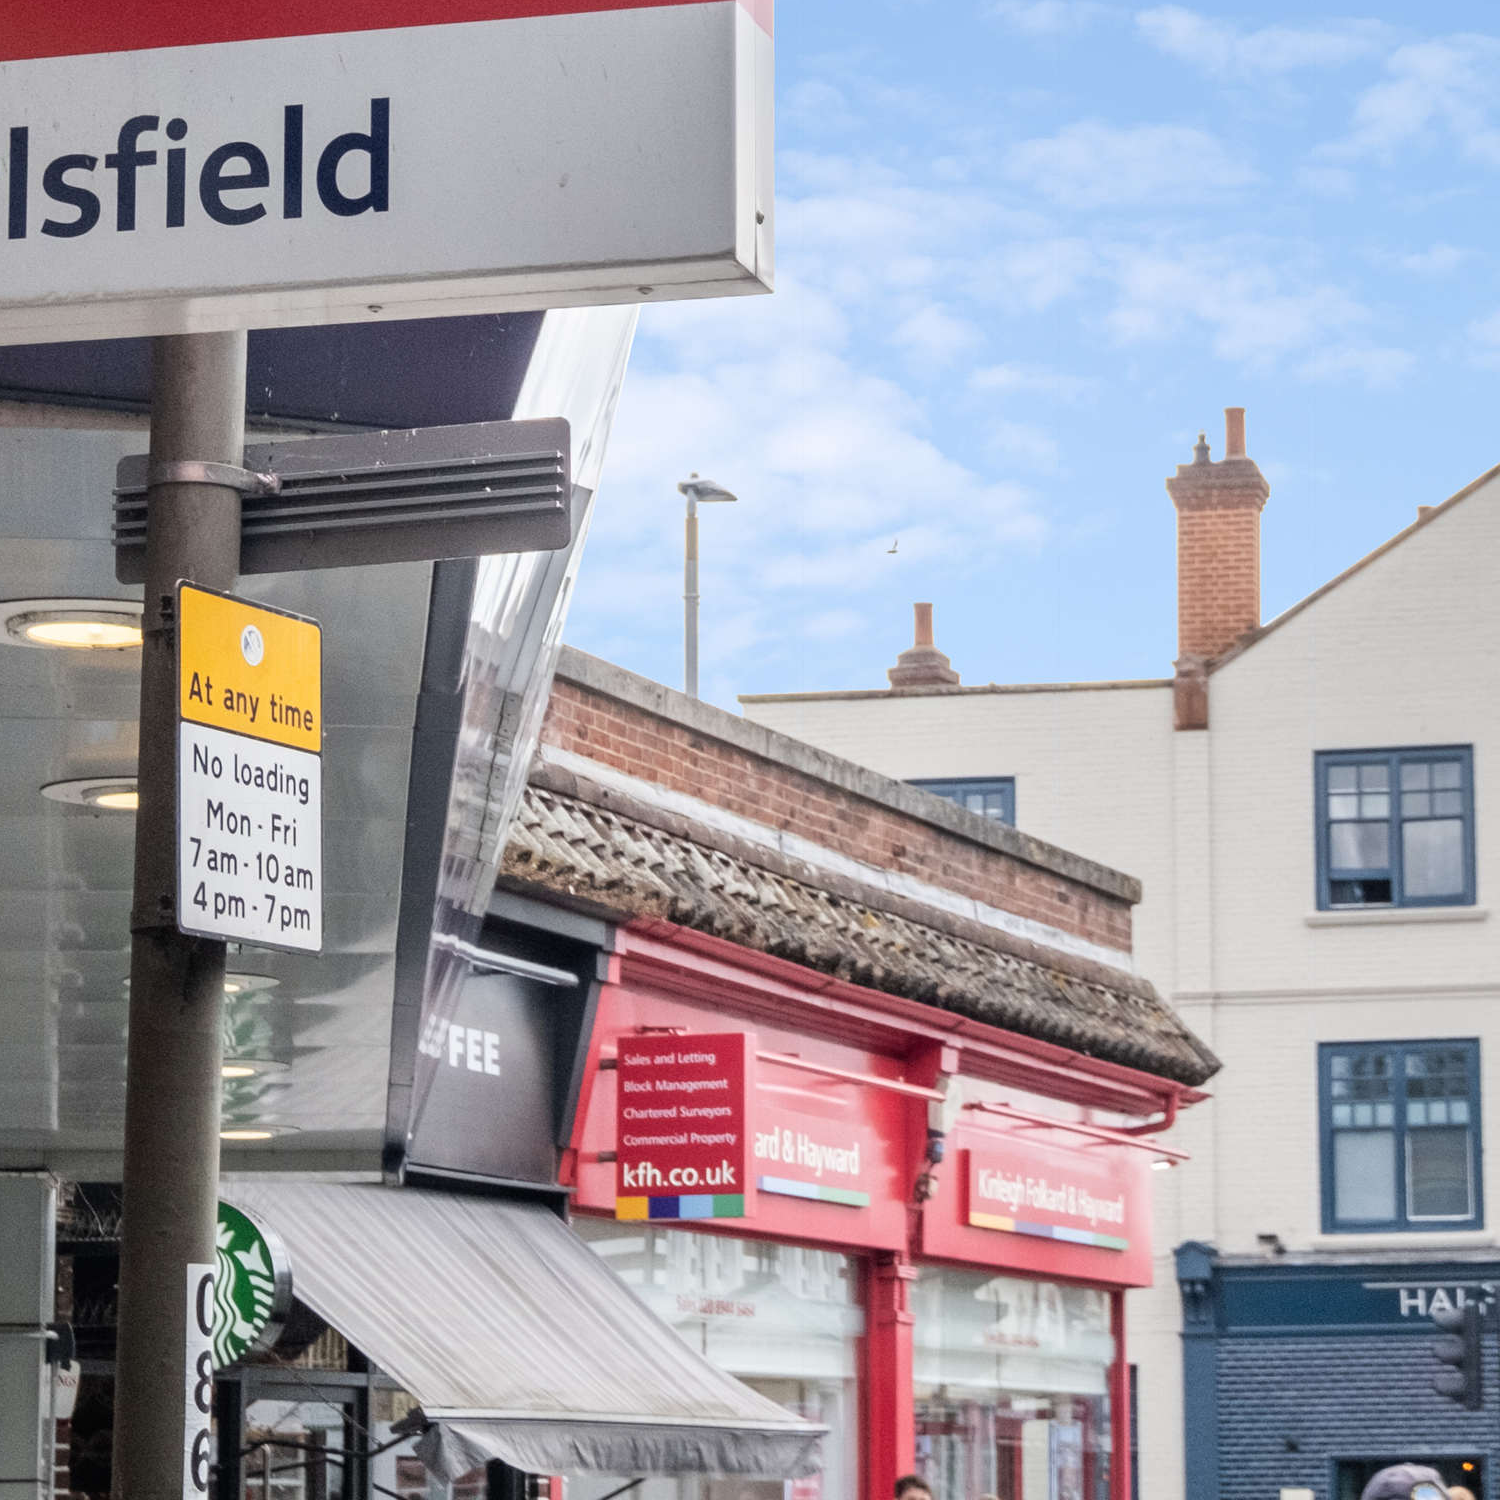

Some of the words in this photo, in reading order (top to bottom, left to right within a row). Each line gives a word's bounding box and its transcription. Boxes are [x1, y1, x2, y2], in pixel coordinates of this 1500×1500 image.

[189, 672, 213, 706] At
[224, 688, 259, 723] any
[270, 693, 313, 731] time
[193, 743, 222, 778] No
[234, 754, 309, 805] loading
[207, 798, 251, 837] Mon
[272, 813, 296, 847] Fri
[624, 1053, 650, 1066] Sales
[654, 1052, 675, 1065] and
[678, 1051, 716, 1066] Letting
[623, 1081, 652, 1093] Block
[656, 1078, 728, 1093] Management
[623, 1106, 677, 1119] Chartered
[680, 1105, 732, 1119] Surveyors
[623, 1133, 687, 1146] Commercial
[690, 1131, 736, 1146] Property
[754, 1126, 781, 1161] ard
[782, 1130, 795, 1164] &
[797, 1132, 861, 1177] Hayward
[623, 1159, 736, 1188] kfh.co.uk
[978, 1169, 1025, 1212] Kinleigh
[1078, 1188, 1125, 1226] Hayward
